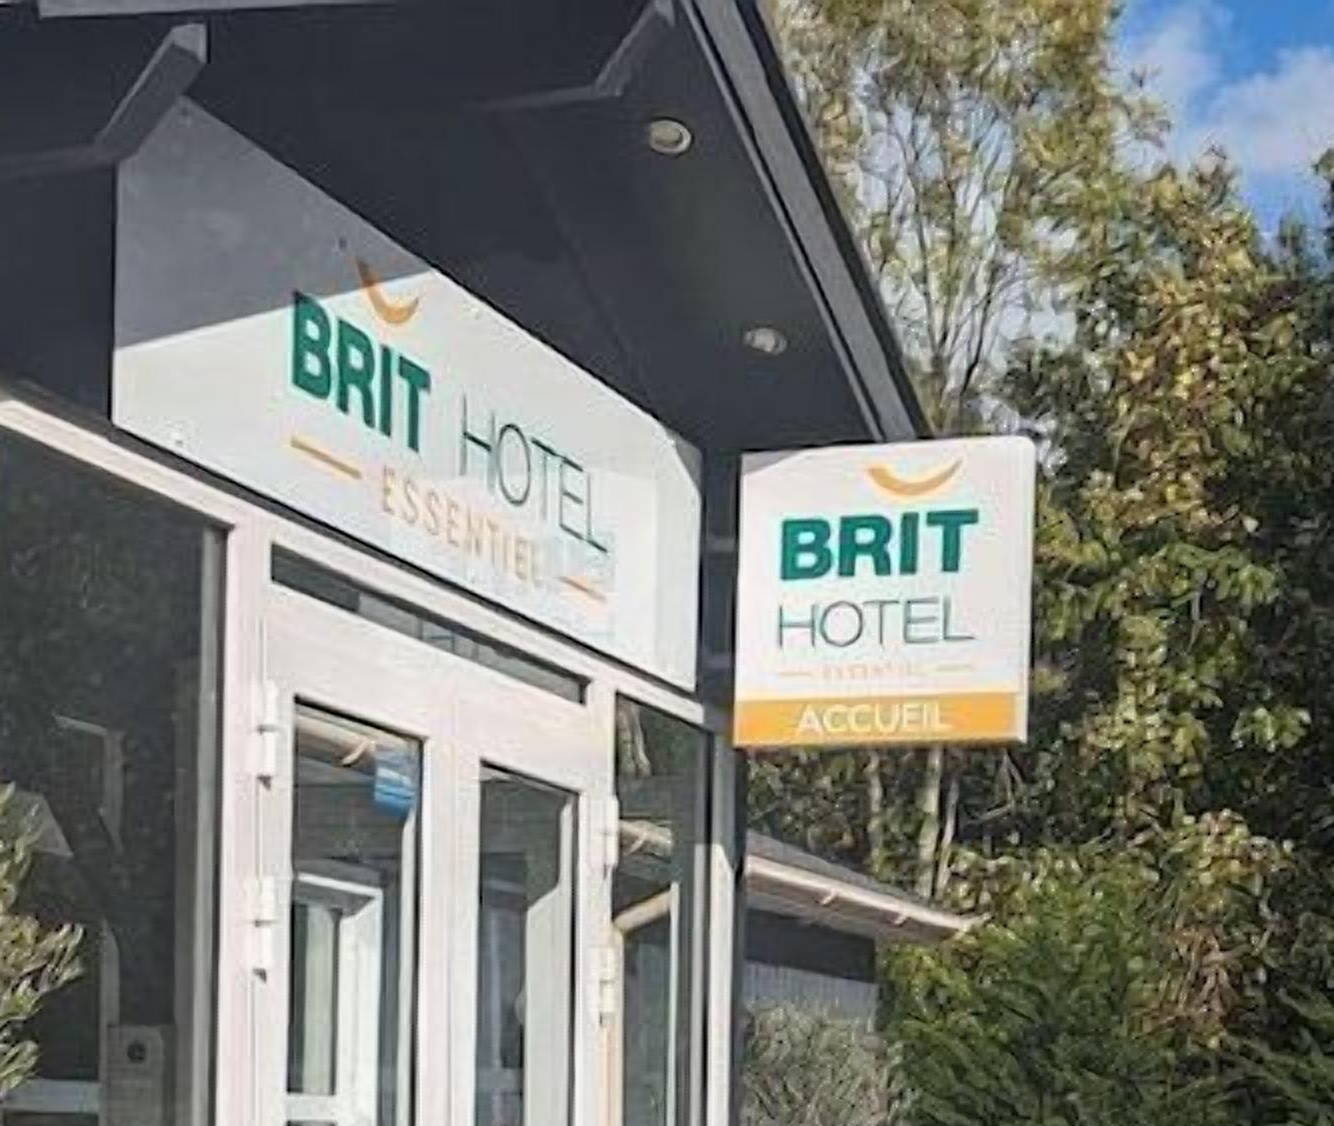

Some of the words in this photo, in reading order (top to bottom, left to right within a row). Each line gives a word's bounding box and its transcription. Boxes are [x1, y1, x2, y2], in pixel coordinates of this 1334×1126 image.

[291, 290, 432, 454] BRIT
[460, 392, 608, 554] HOTEL
[380, 464, 542, 588] ESSENTIEL
[780, 509, 979, 581] BRIT
[777, 596, 978, 650] HOTEL
[796, 702, 951, 735] ACCUEIL
